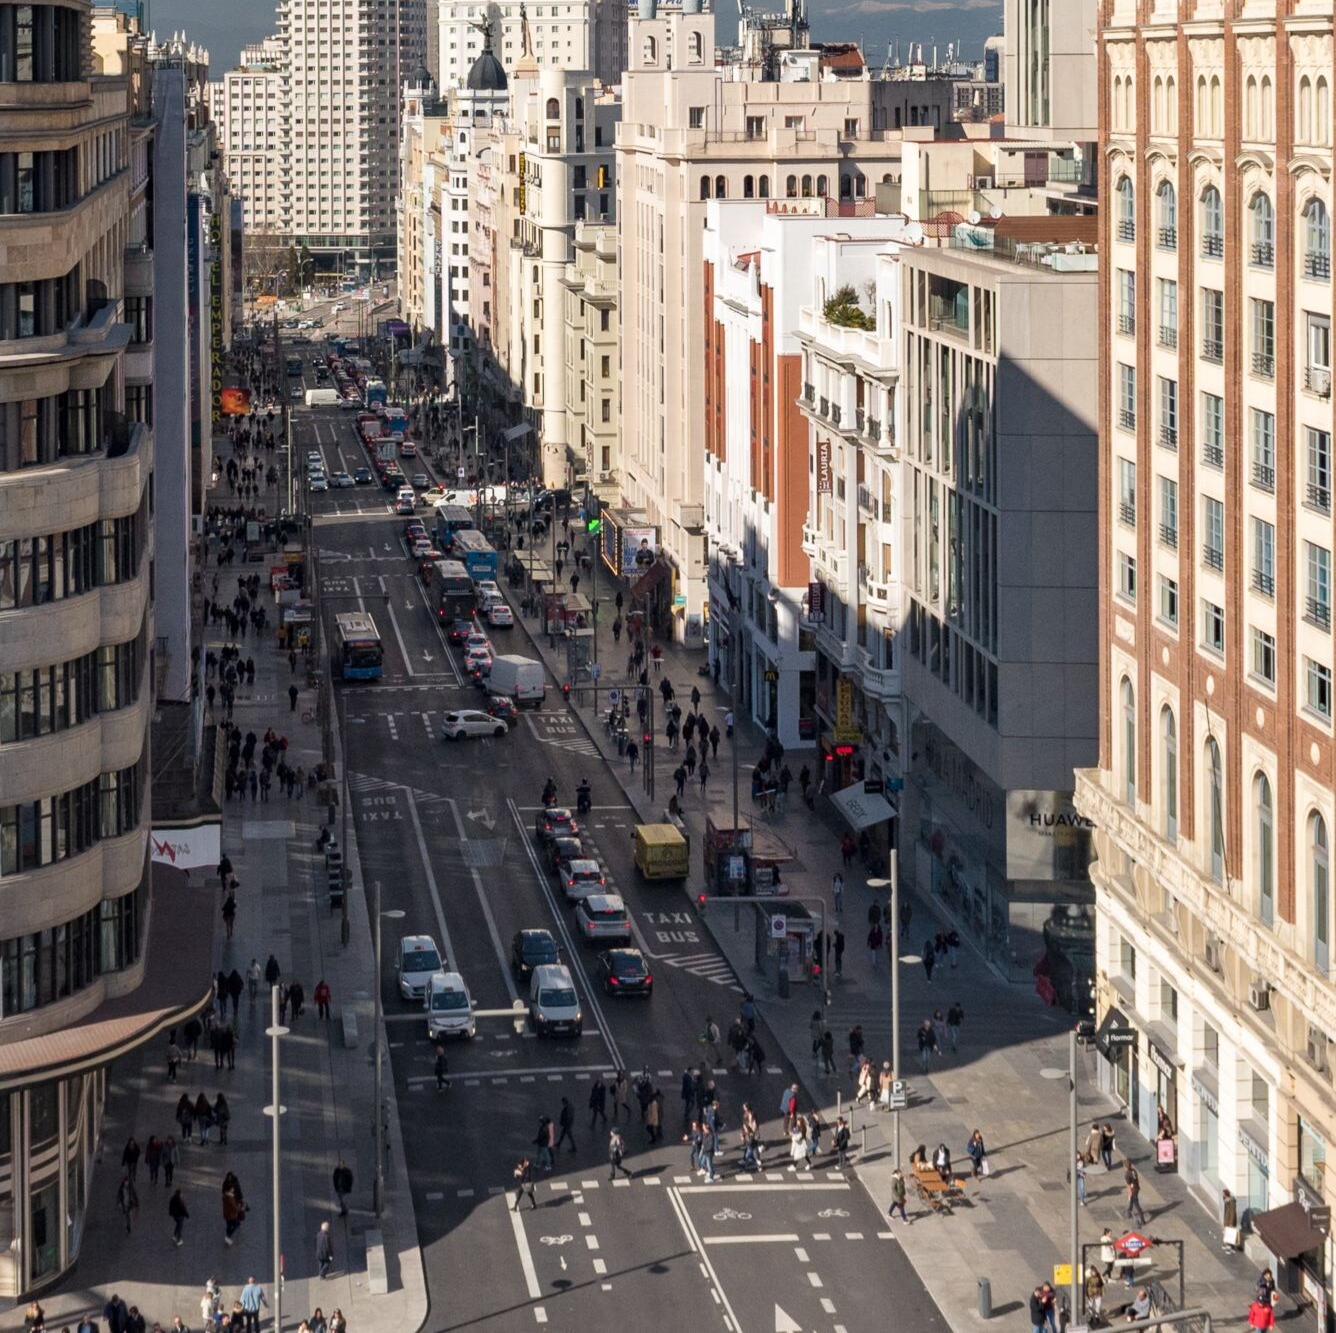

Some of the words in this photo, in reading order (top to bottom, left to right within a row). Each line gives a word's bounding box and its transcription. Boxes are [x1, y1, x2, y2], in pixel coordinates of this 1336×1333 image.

[211, 296, 222, 422] EMPERADOR
[820, 443, 829, 481] LAURIA
[362, 796, 397, 806] BUS
[362, 811, 403, 821] TAXI
[1030, 814, 1098, 827] HUAWE
[642, 912, 692, 924] TAXI
[655, 931, 700, 942] BUS
[1110, 1034, 1134, 1042] flormar
